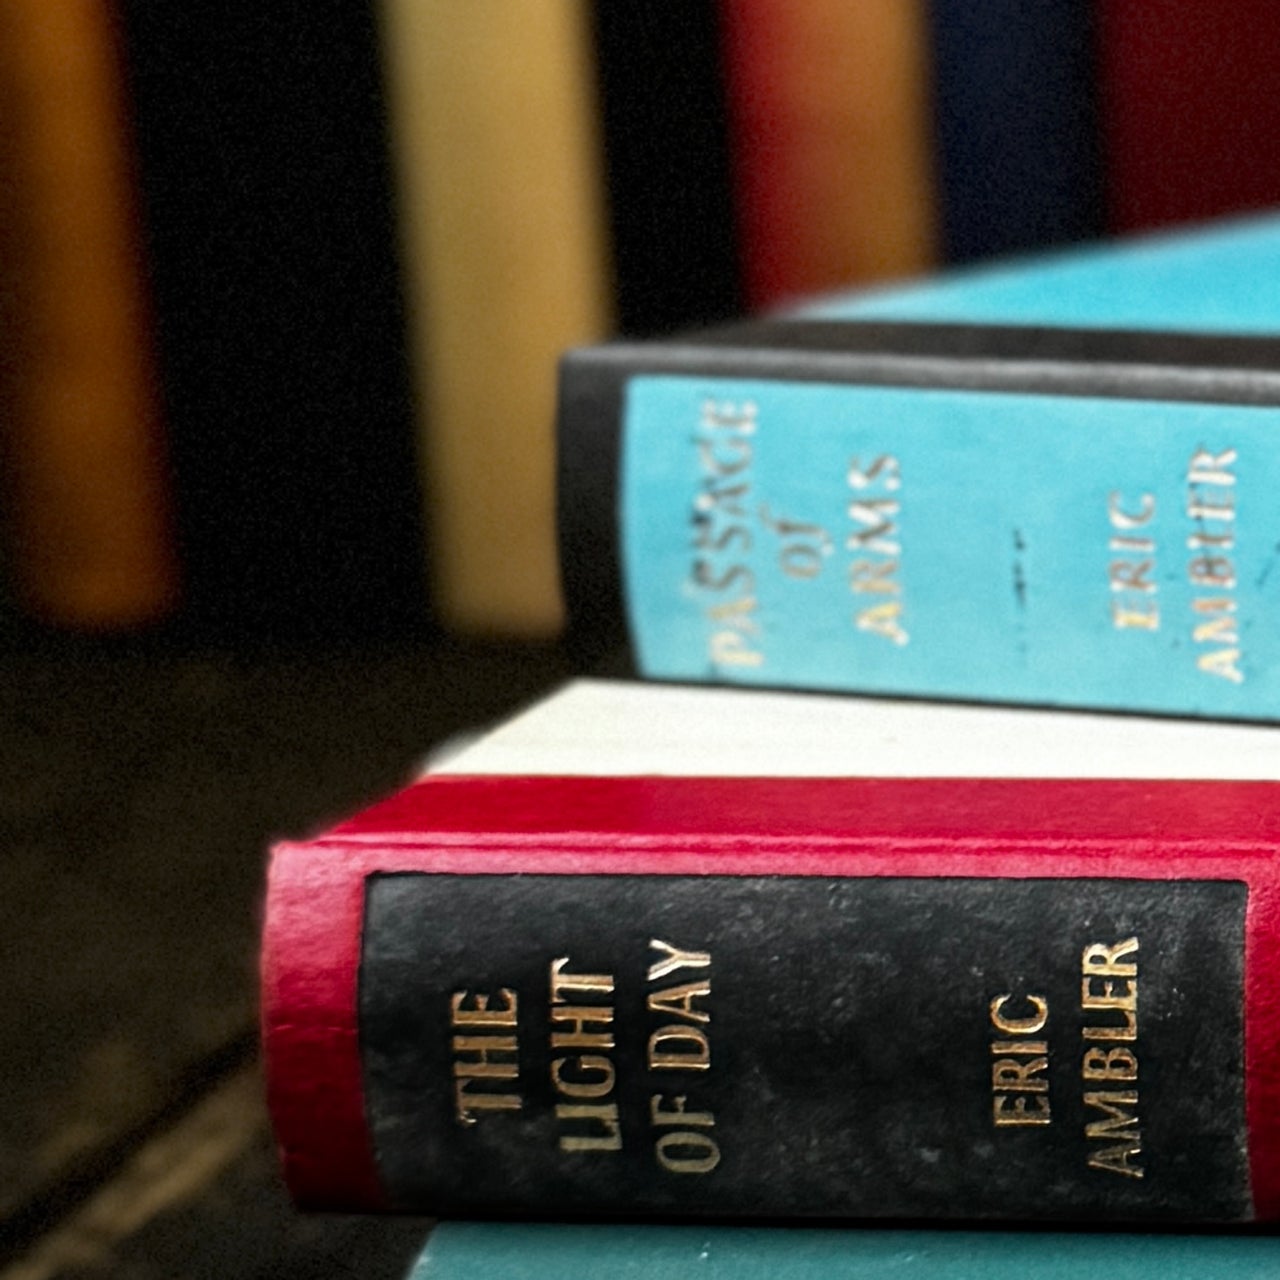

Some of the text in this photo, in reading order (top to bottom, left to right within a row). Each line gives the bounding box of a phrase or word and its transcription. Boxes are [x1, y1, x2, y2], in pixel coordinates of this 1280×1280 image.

[846, 452, 910, 646] ARMS
[1108, 490, 1160, 632] ERIC
[1186, 446, 1244, 685] AMBLER
[450, 986, 524, 1126] THE
[548, 956, 624, 1154] LIGHT
[646, 938, 722, 1174] OF DAY
[990, 992, 1052, 1128] ERIC
[1081, 935, 1146, 1179] AMBLER
